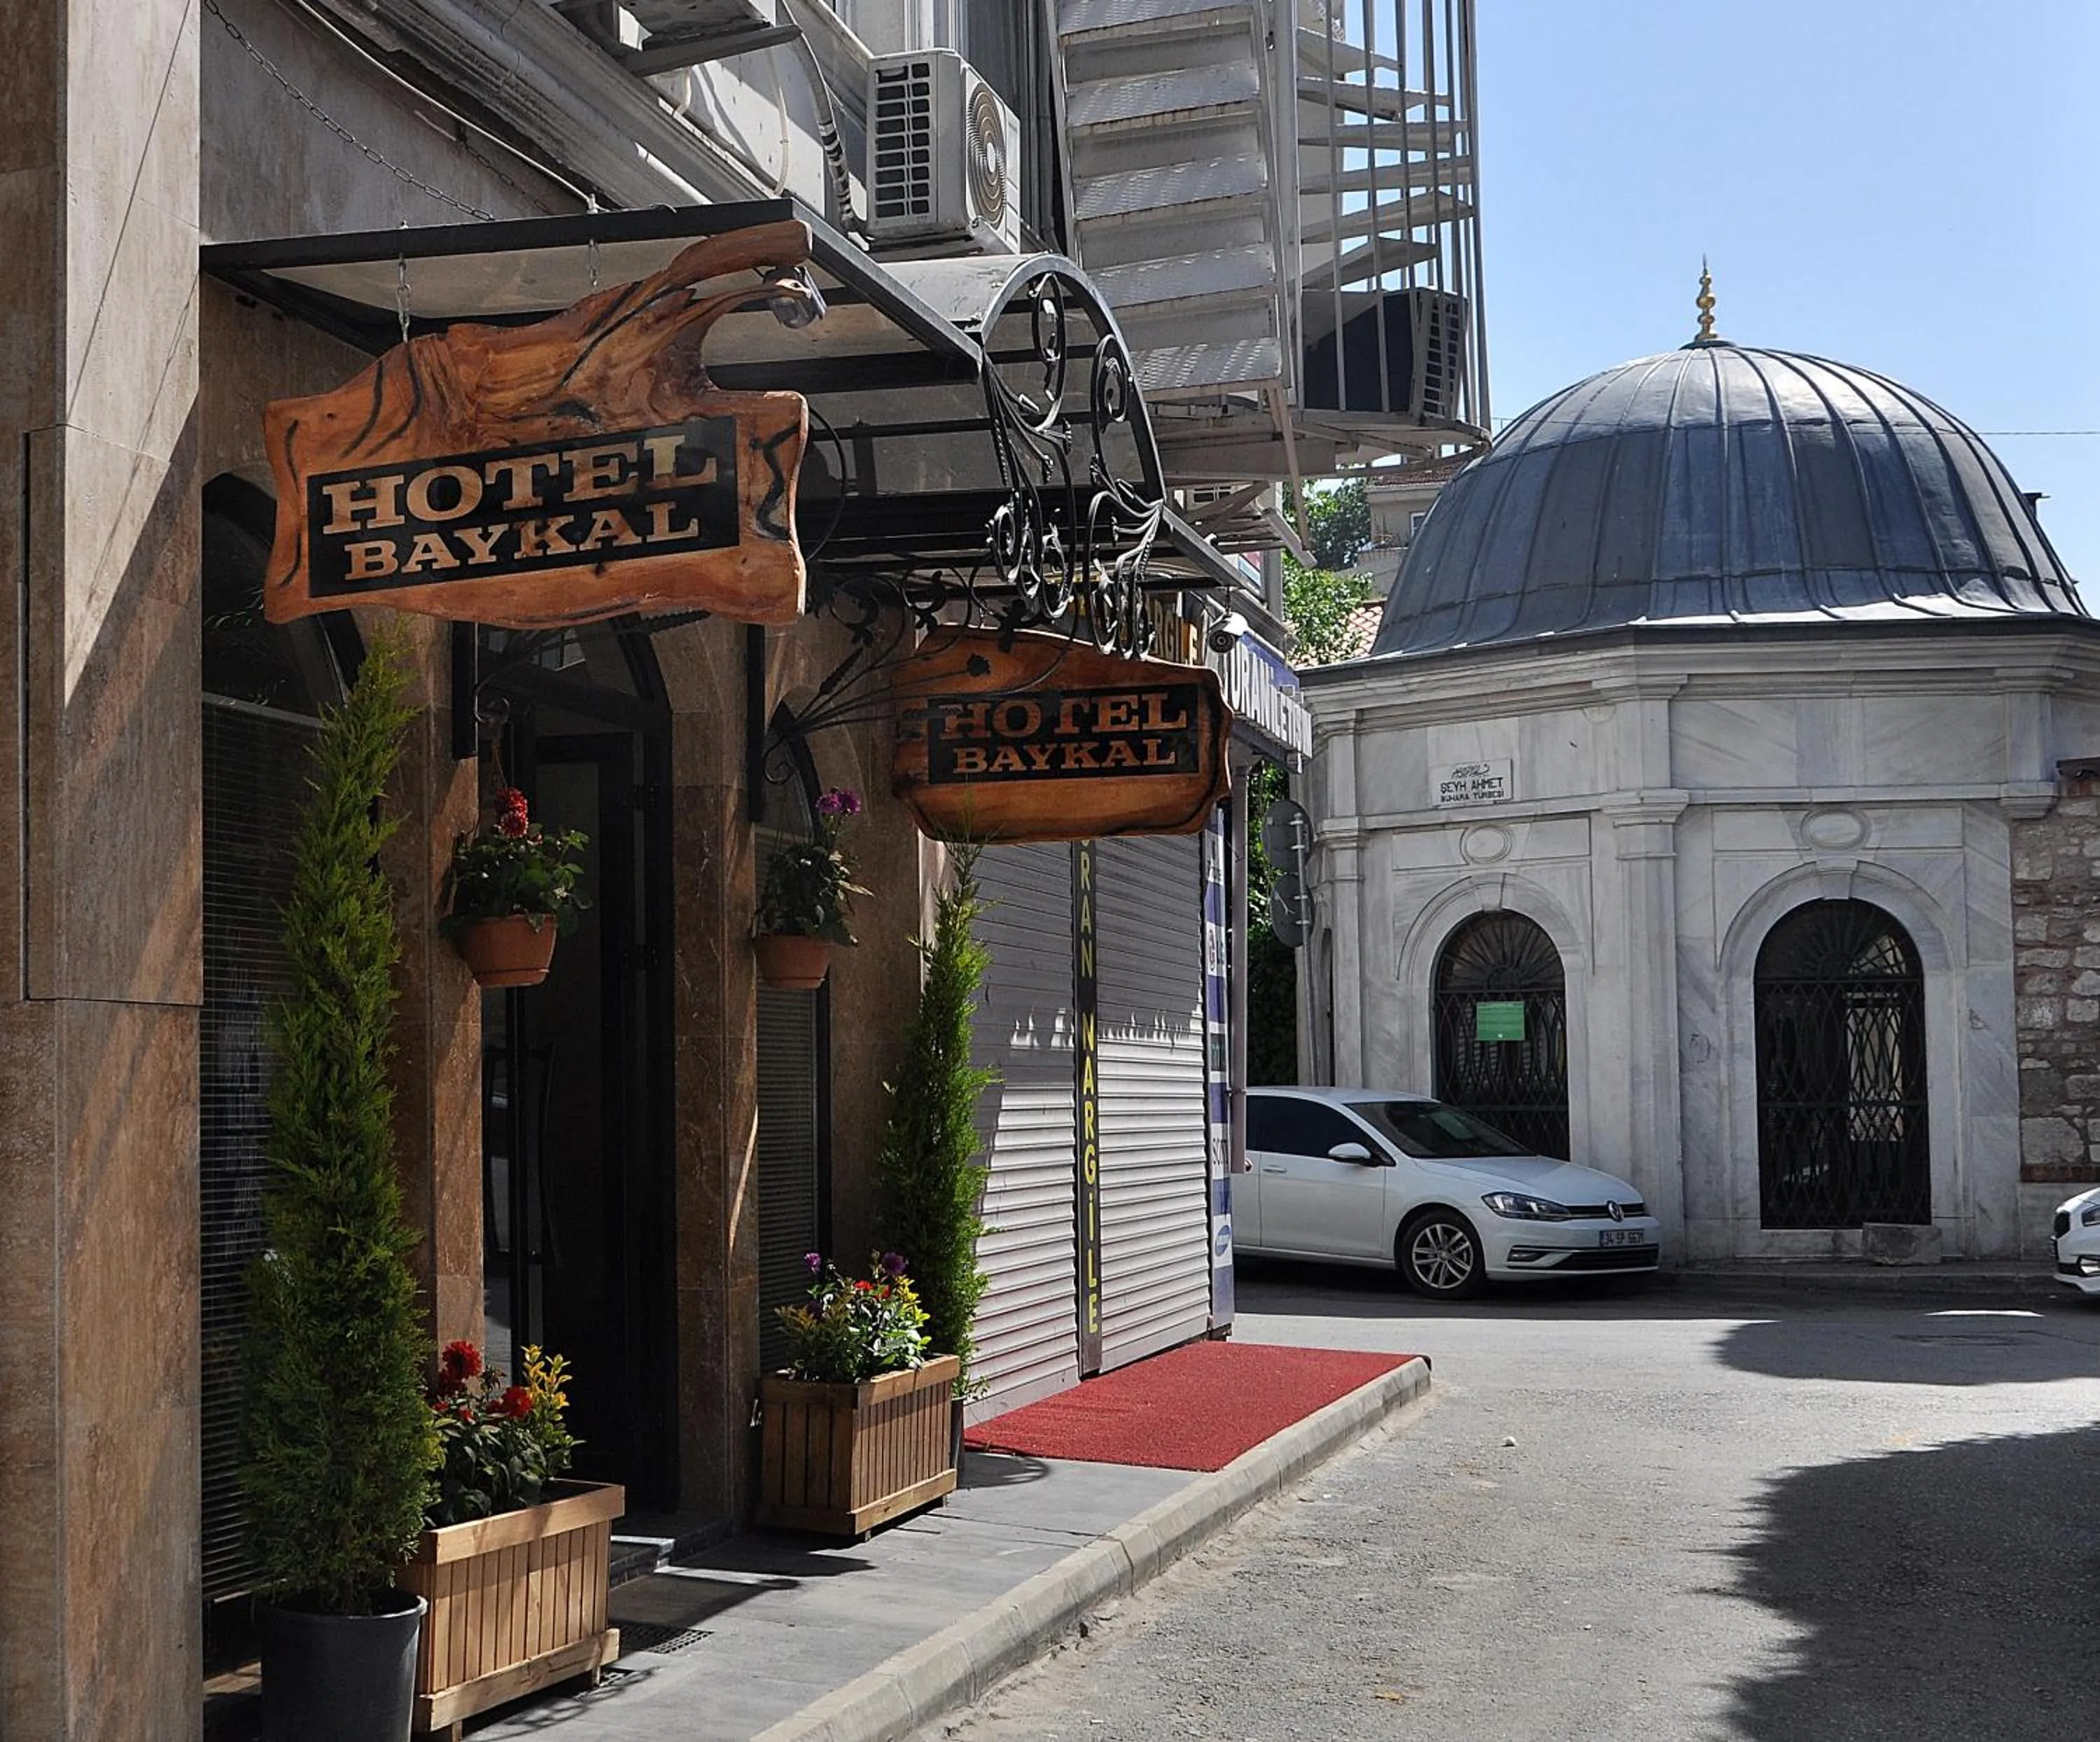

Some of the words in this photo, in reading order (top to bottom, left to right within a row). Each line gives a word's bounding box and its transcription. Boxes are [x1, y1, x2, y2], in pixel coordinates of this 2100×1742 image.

[321, 434, 718, 535] HOTEL
[344, 501, 699, 581] BAYKAL
[938, 692, 1187, 741] HOTEL
[952, 738, 1176, 774] BAYKAL
[1471, 776, 1504, 790] AHMET
